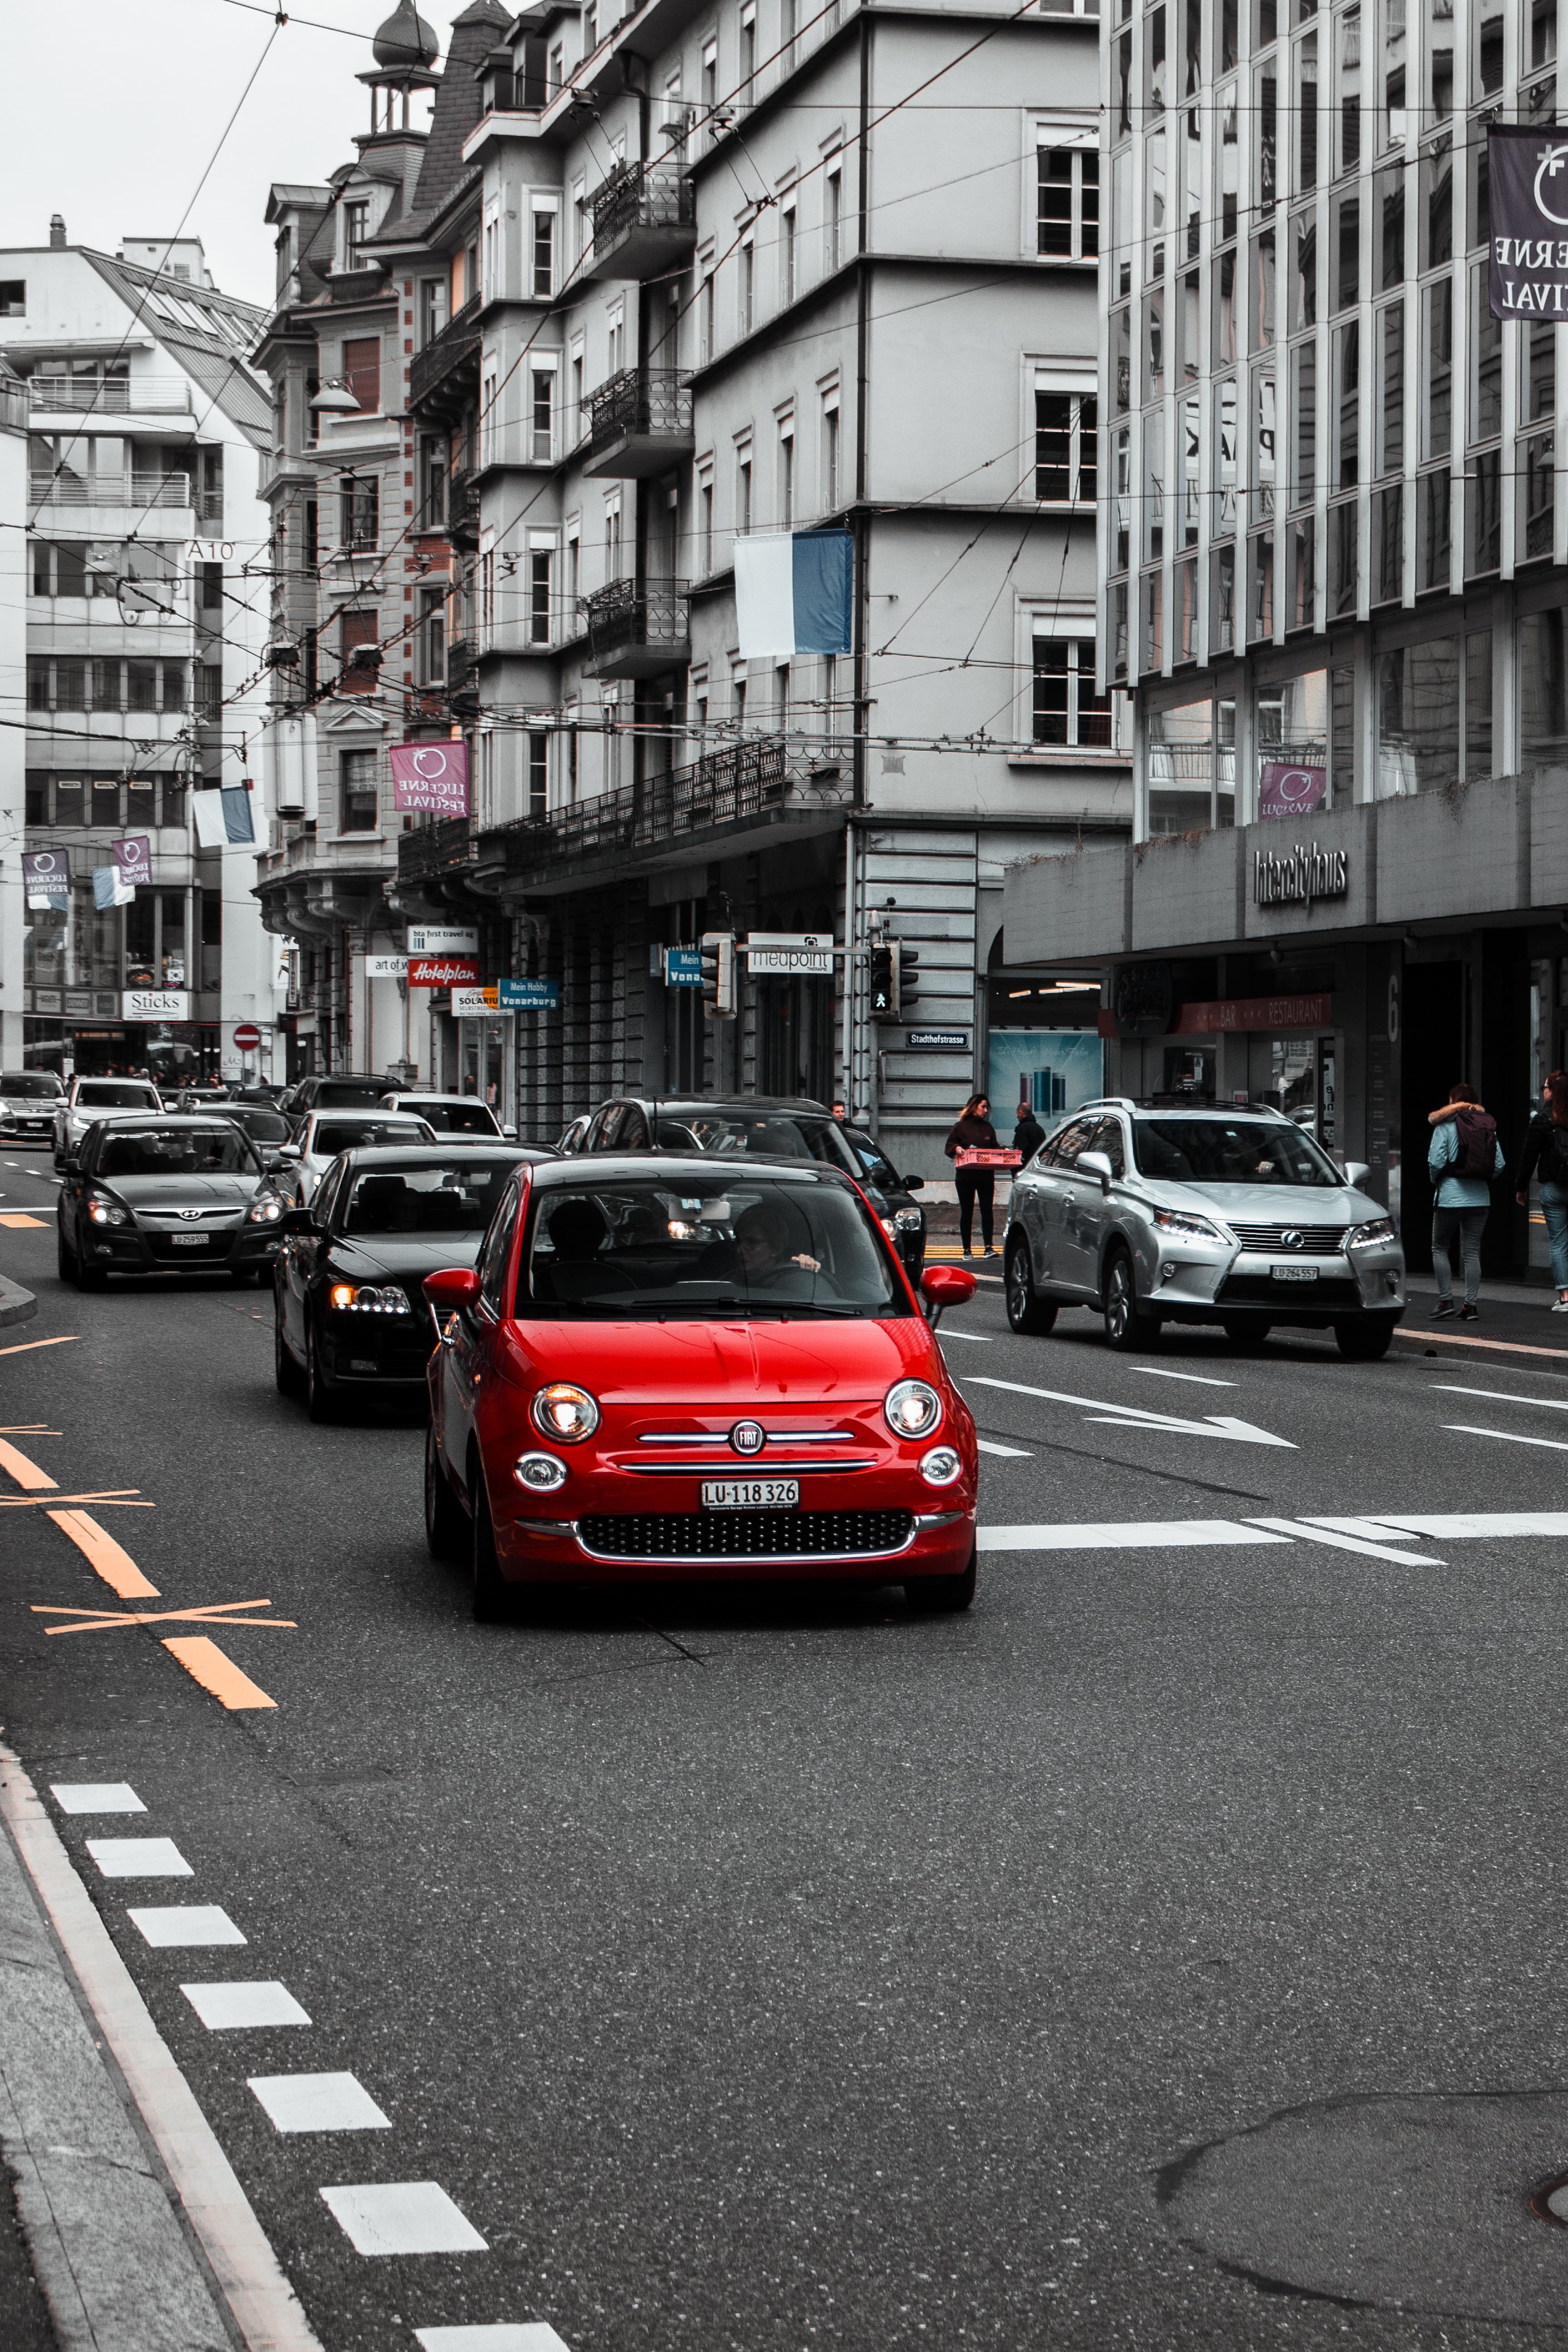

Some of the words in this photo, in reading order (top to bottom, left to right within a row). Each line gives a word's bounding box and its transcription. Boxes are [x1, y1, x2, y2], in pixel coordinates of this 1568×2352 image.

[1254, 842, 1347, 908] Intercityhaus
[427, 930, 441, 938] first
[376, 960, 388, 970] art
[391, 959, 400, 970] of
[681, 954, 699, 965] Mein
[413, 962, 476, 985] Hotelplan
[510, 982, 526, 991] Mein
[528, 981, 548, 993] Hobby
[132, 993, 179, 1008] Sticks
[501, 997, 556, 1007] Vonarburg
[1220, 1005, 1236, 1027] BAR
[1268, 999, 1323, 1024] RESTAURANT
[1388, 975, 1398, 1042] 6
[911, 1034, 964, 1044] Stadthofstrasse
[739, 1431, 758, 1446] FIAT
